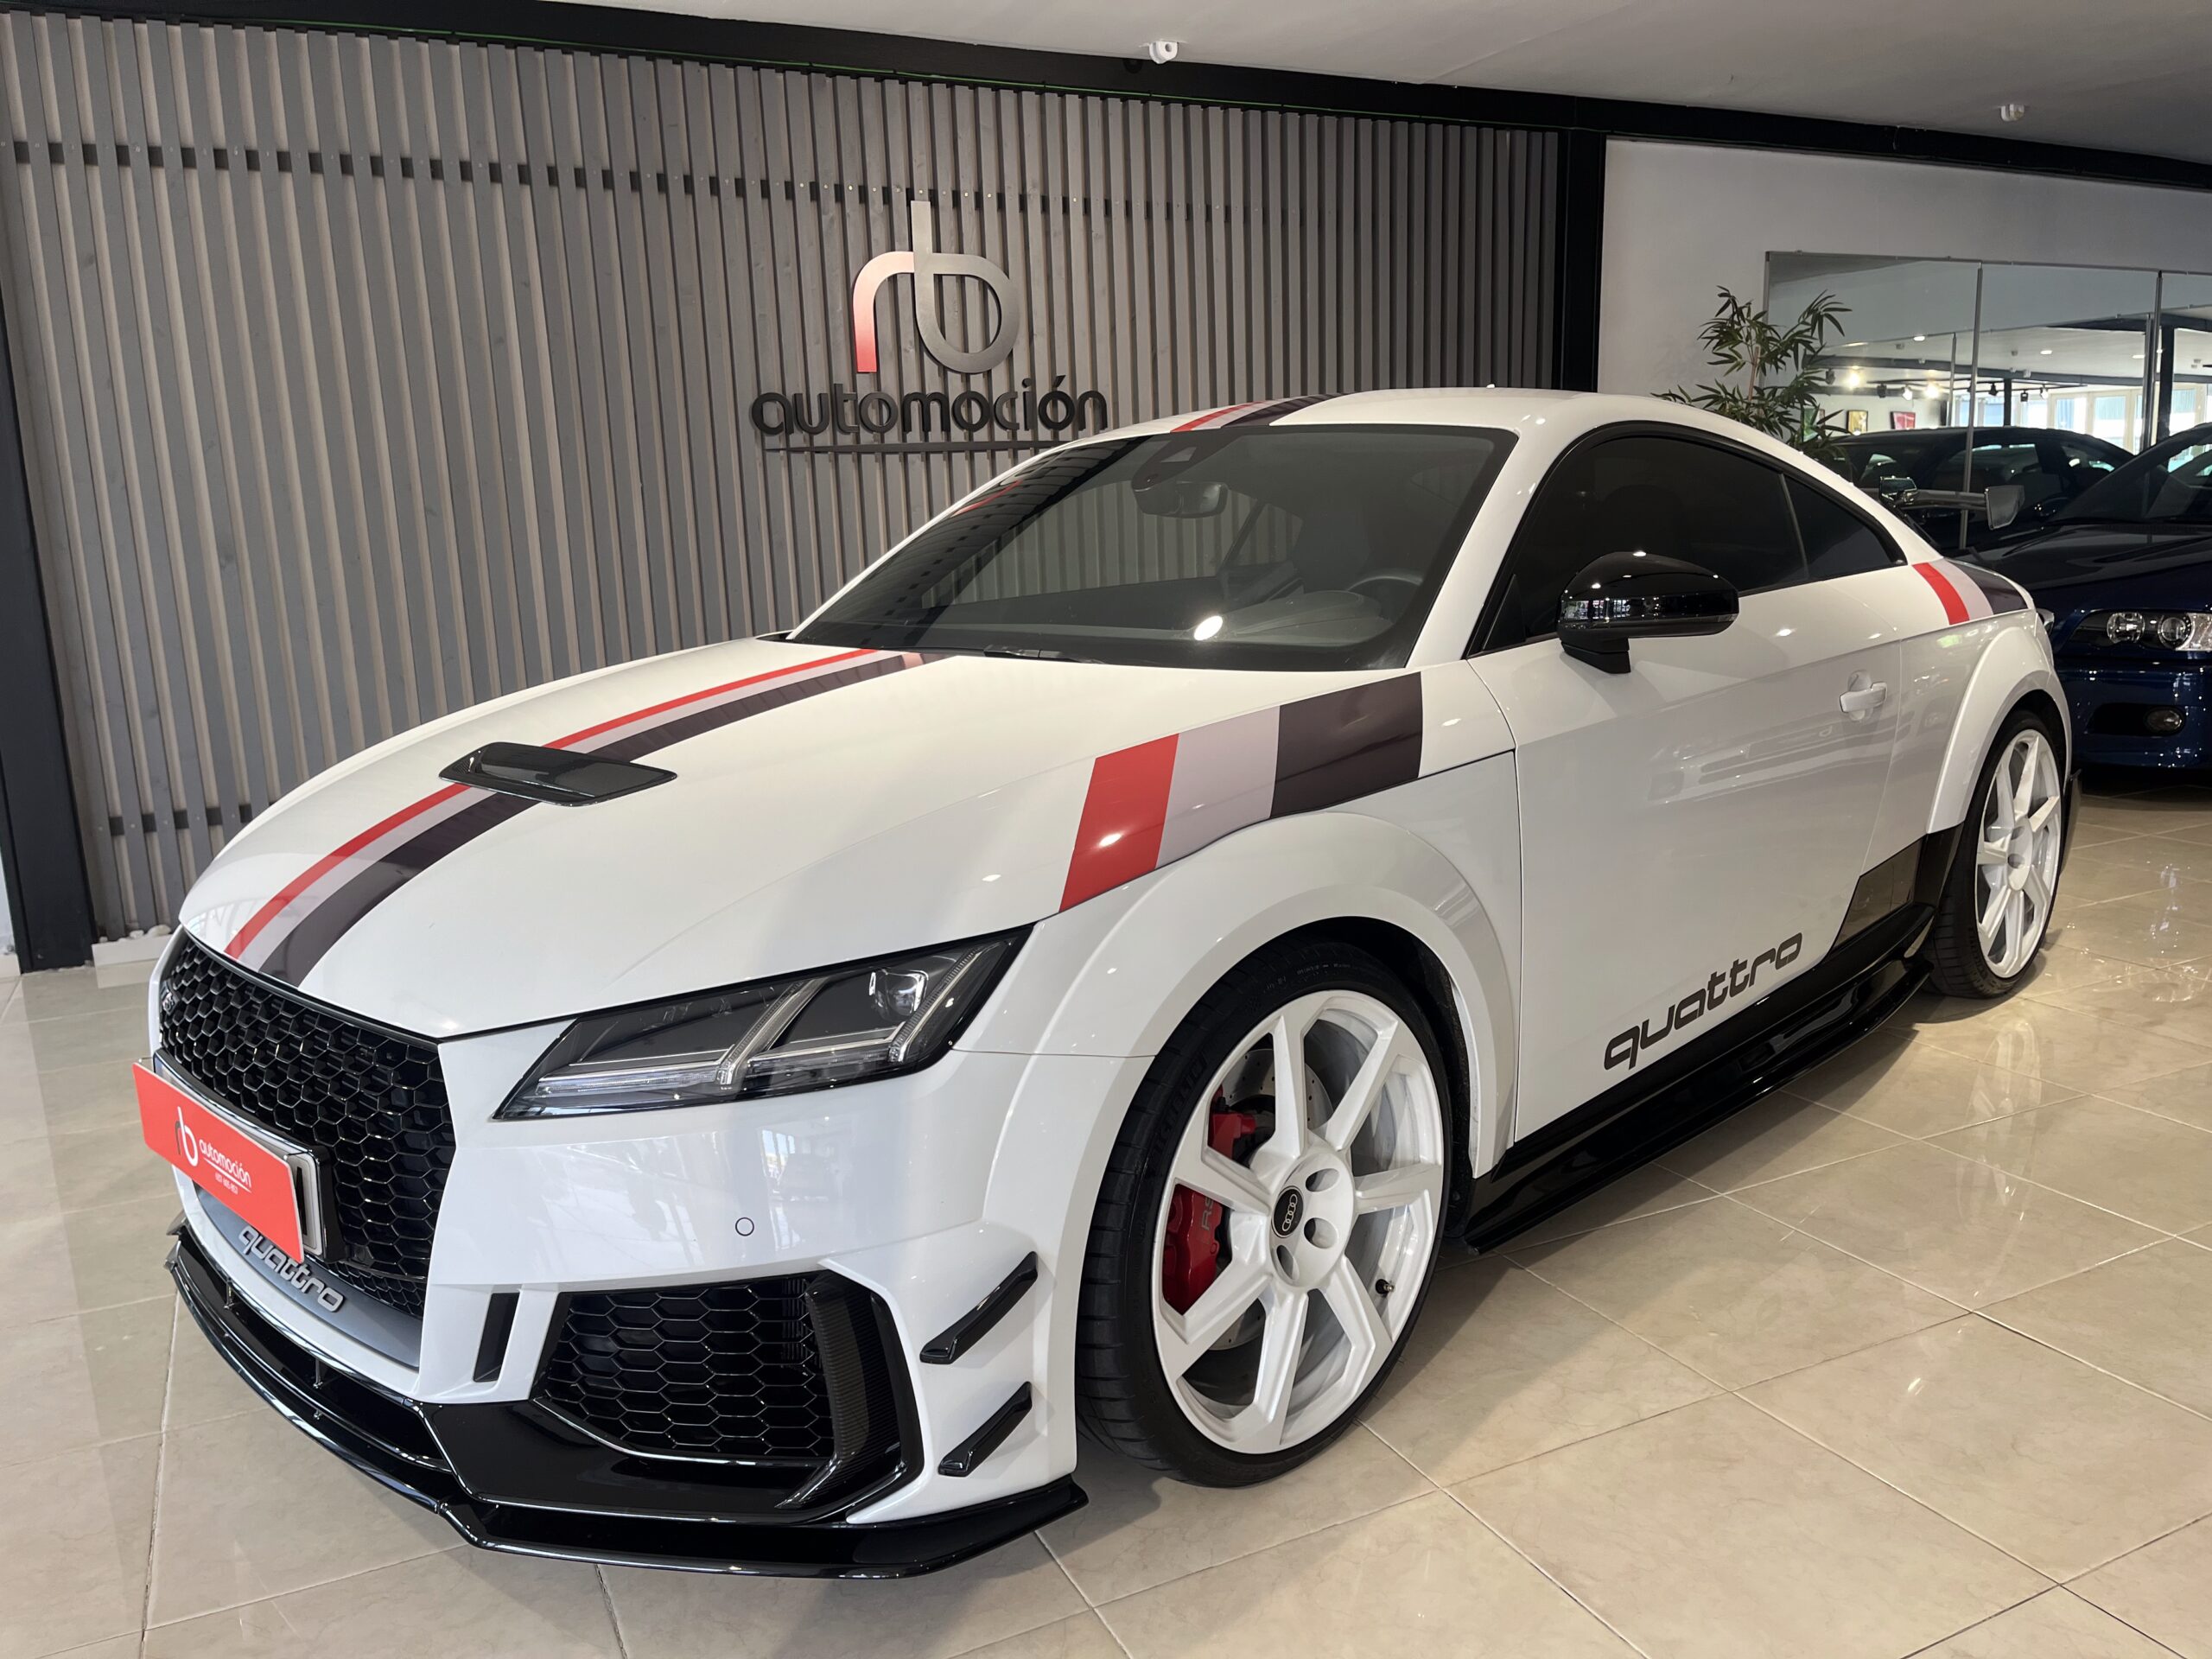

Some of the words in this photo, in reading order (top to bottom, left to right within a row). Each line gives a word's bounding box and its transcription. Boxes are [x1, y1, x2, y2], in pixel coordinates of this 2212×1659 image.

[751, 375, 1109, 435] automoción
[1604, 931, 1803, 1071] quattro
[199, 1139, 252, 1189] automoción
[238, 1225, 344, 1313] quattro
